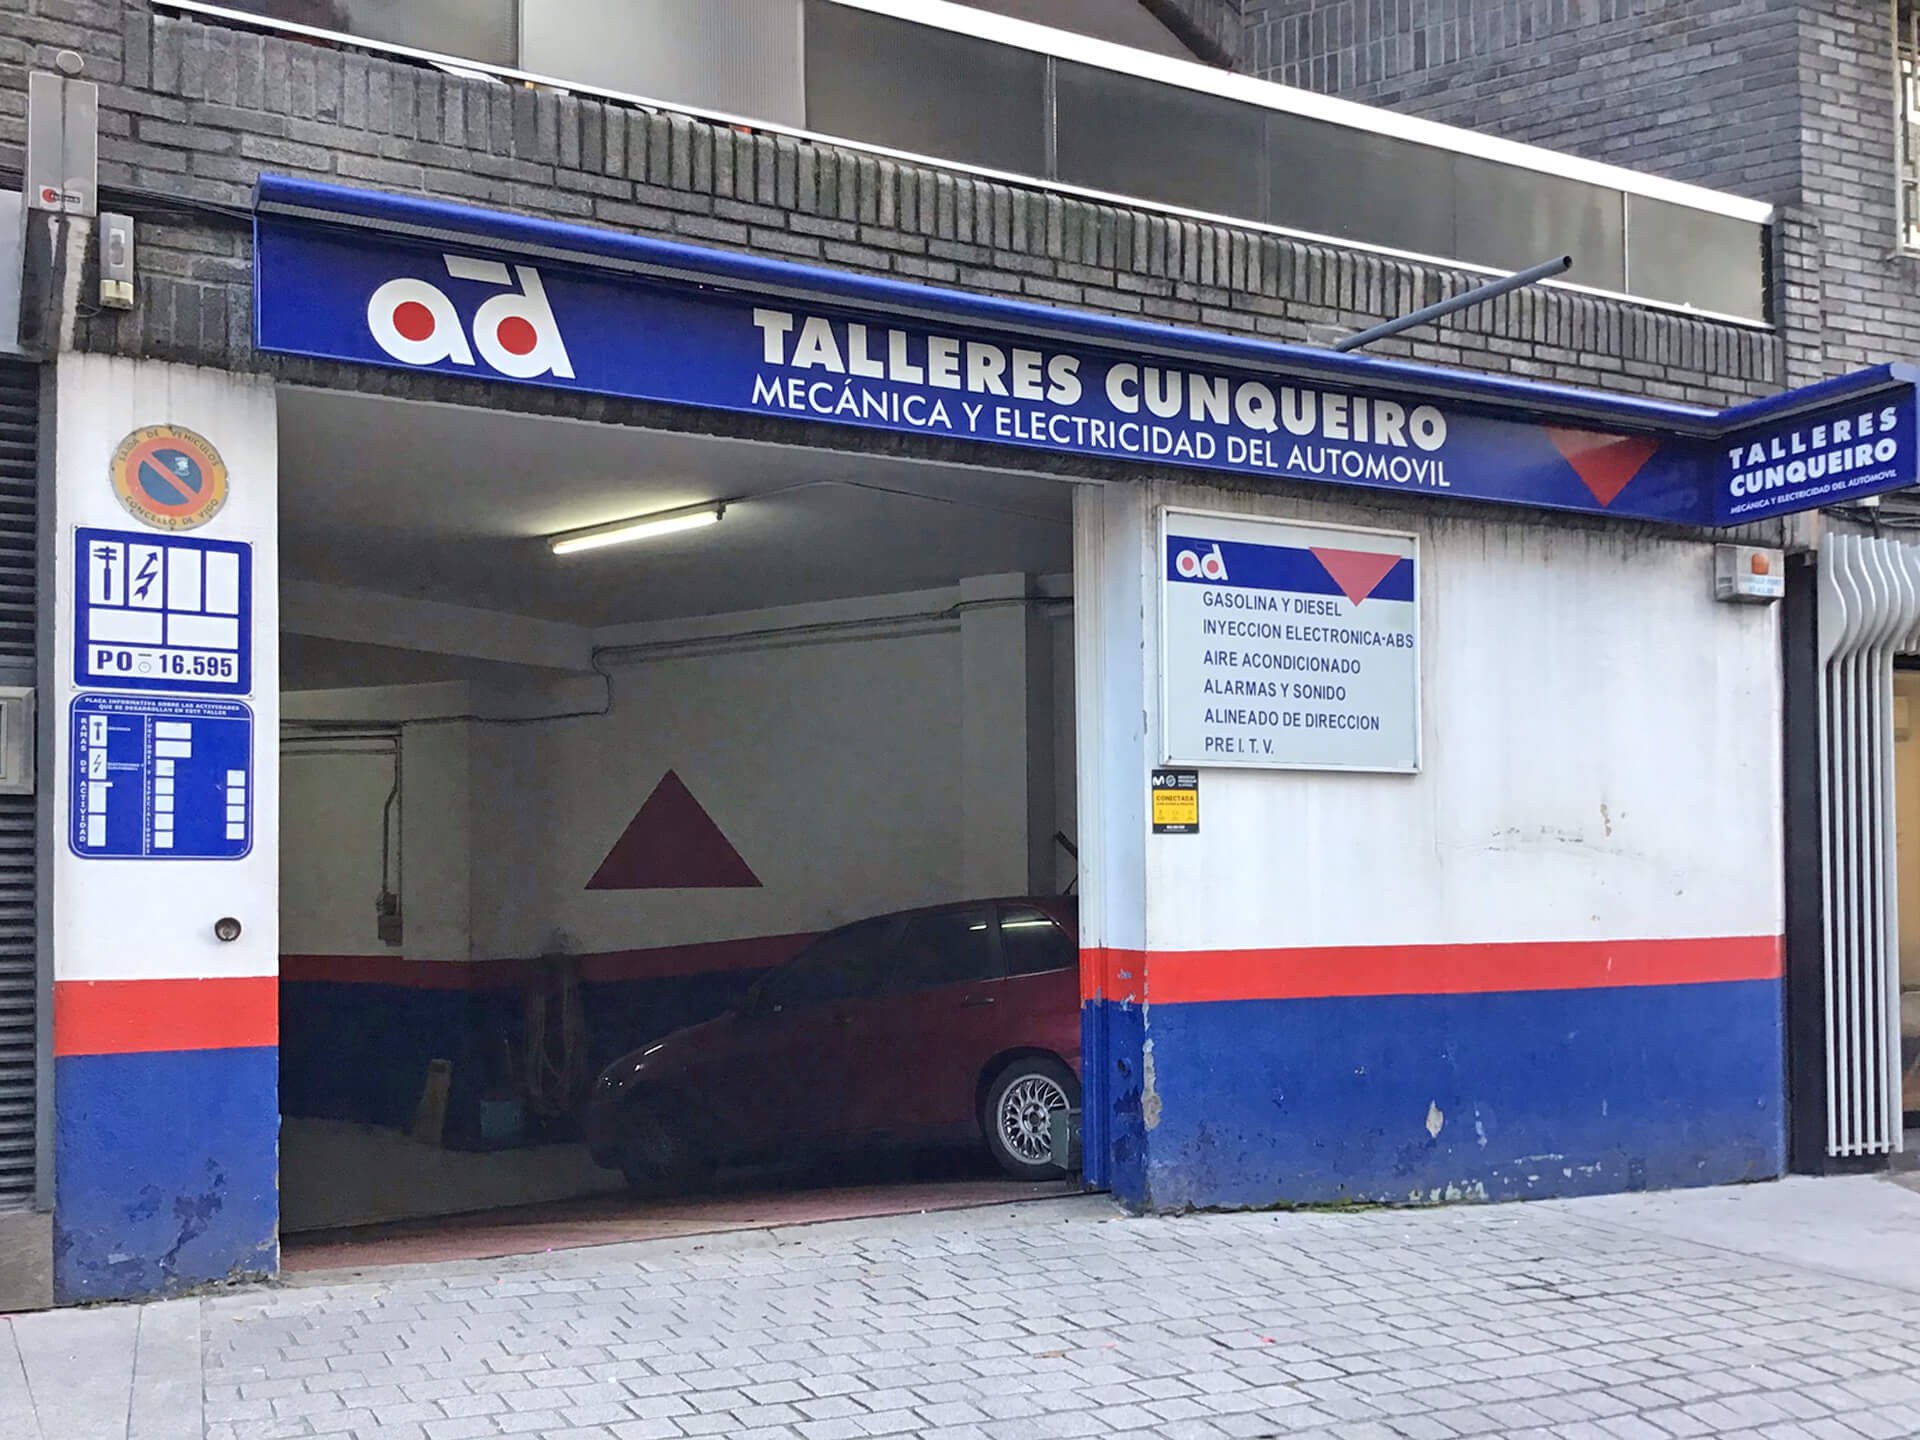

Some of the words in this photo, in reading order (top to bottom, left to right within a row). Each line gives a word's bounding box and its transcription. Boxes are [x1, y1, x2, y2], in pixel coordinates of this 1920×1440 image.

[367, 254, 577, 380] ad
[753, 307, 1083, 406] TALLERES
[1105, 363, 1447, 452] CUNQUEIRO
[751, 373, 953, 429] MECÁNICA
[962, 401, 984, 433] Y
[995, 406, 1216, 461] ELECTRICIDAD
[1227, 435, 1279, 469] DEL
[1286, 444, 1451, 488] AUTOMOVIL
[1728, 406, 1898, 470] TALLERES
[1729, 437, 1898, 498] CUNQUEIRO
[1777, 484, 1830, 504] ELECTRICIDAD
[1832, 481, 1847, 491] DEL
[1175, 543, 1229, 581] ad
[1203, 590, 1278, 612] GASOLINA
[1281, 598, 1290, 612] Y
[1294, 598, 1342, 617] DIESEL
[1203, 619, 1281, 640] INYECCION
[97, 650, 133, 671] PO
[159, 653, 233, 678] 16.595
[1203, 649, 1238, 667] AIRE
[1242, 652, 1361, 675] ACONDICIONADO
[1204, 678, 1277, 698] ALARMAS
[1280, 683, 1290, 698] Y
[1293, 683, 1347, 702] SONIDO
[1204, 707, 1279, 727] ALINEADO
[1282, 712, 1301, 727] DE
[1305, 713, 1380, 731] DIRECCION
[80, 717, 88, 752] RAMAS
[1205, 736, 1234, 752] PRE
[80, 760, 87, 774] DE
[79, 780, 87, 843] ACTIVIDAD
